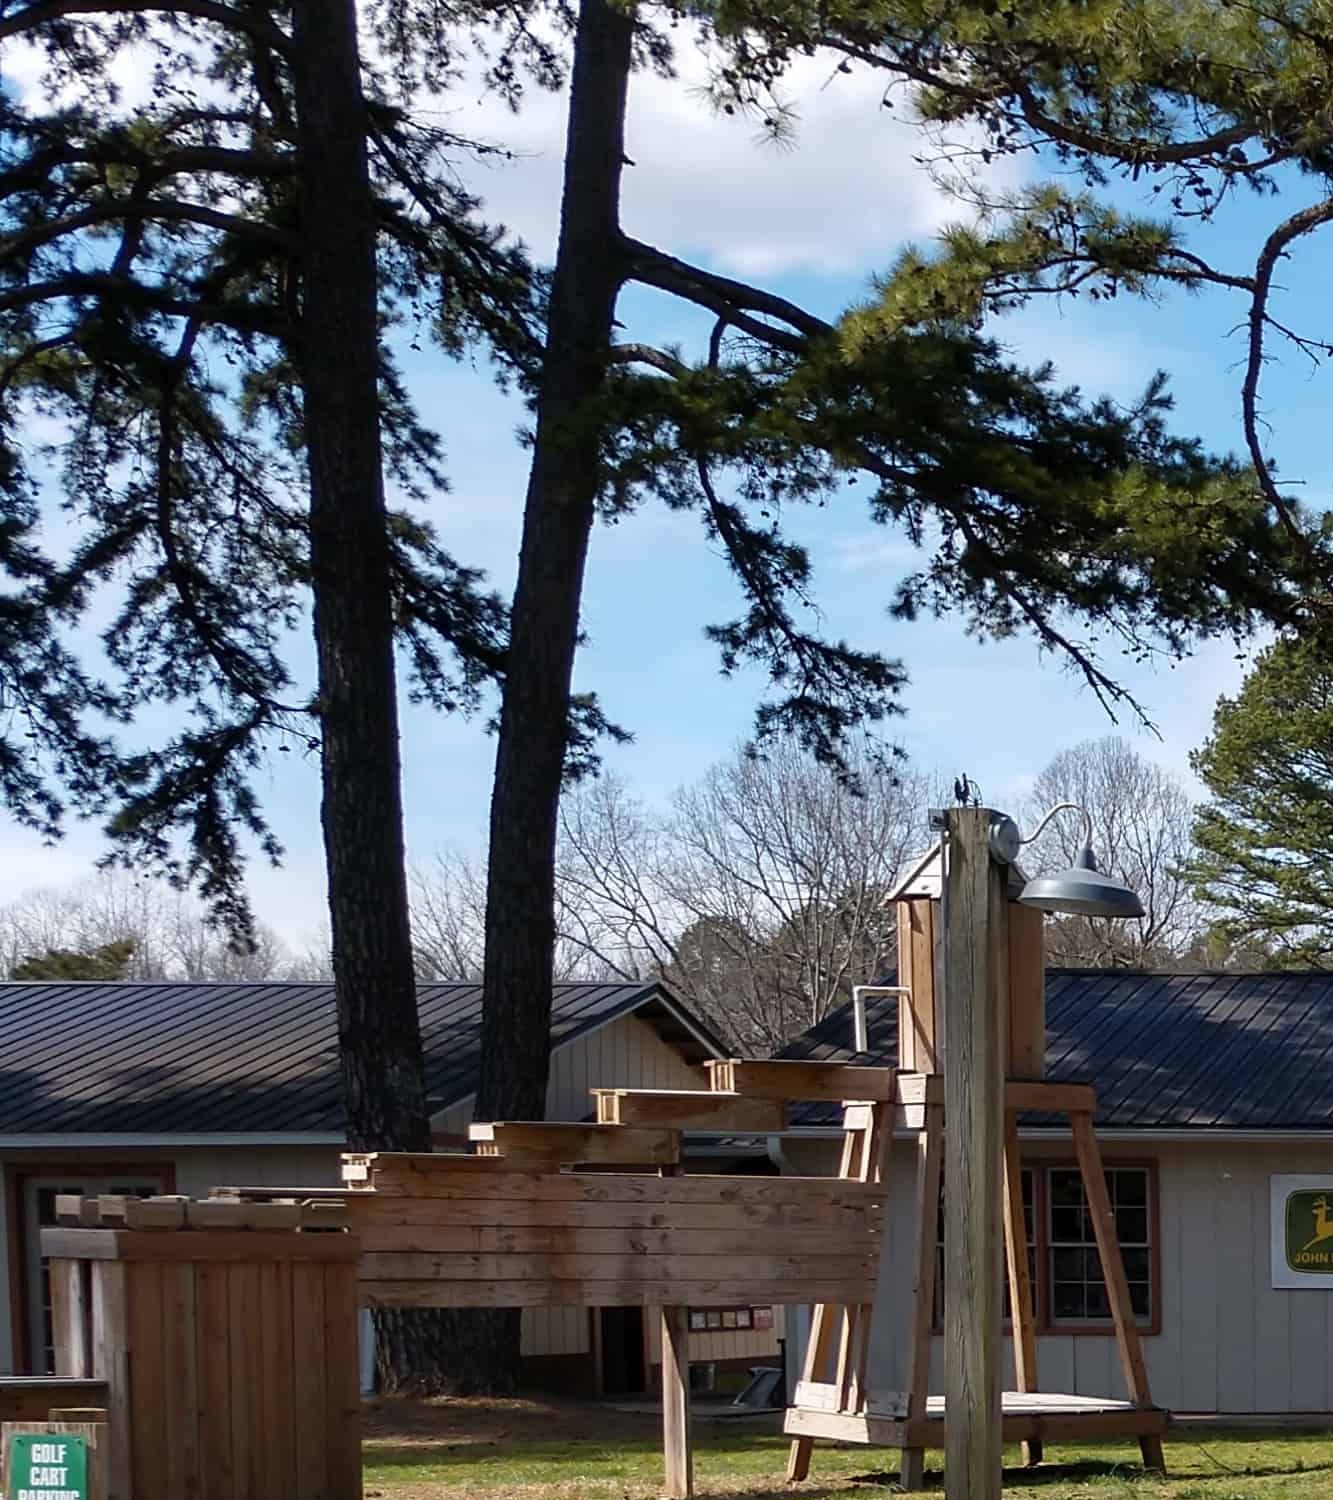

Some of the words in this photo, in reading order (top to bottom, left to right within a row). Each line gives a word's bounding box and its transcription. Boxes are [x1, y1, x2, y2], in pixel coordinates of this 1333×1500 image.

[1295, 1253, 1329, 1263] JOHN
[31, 1443, 67, 1463] GOLF
[30, 1467, 68, 1486] CART
